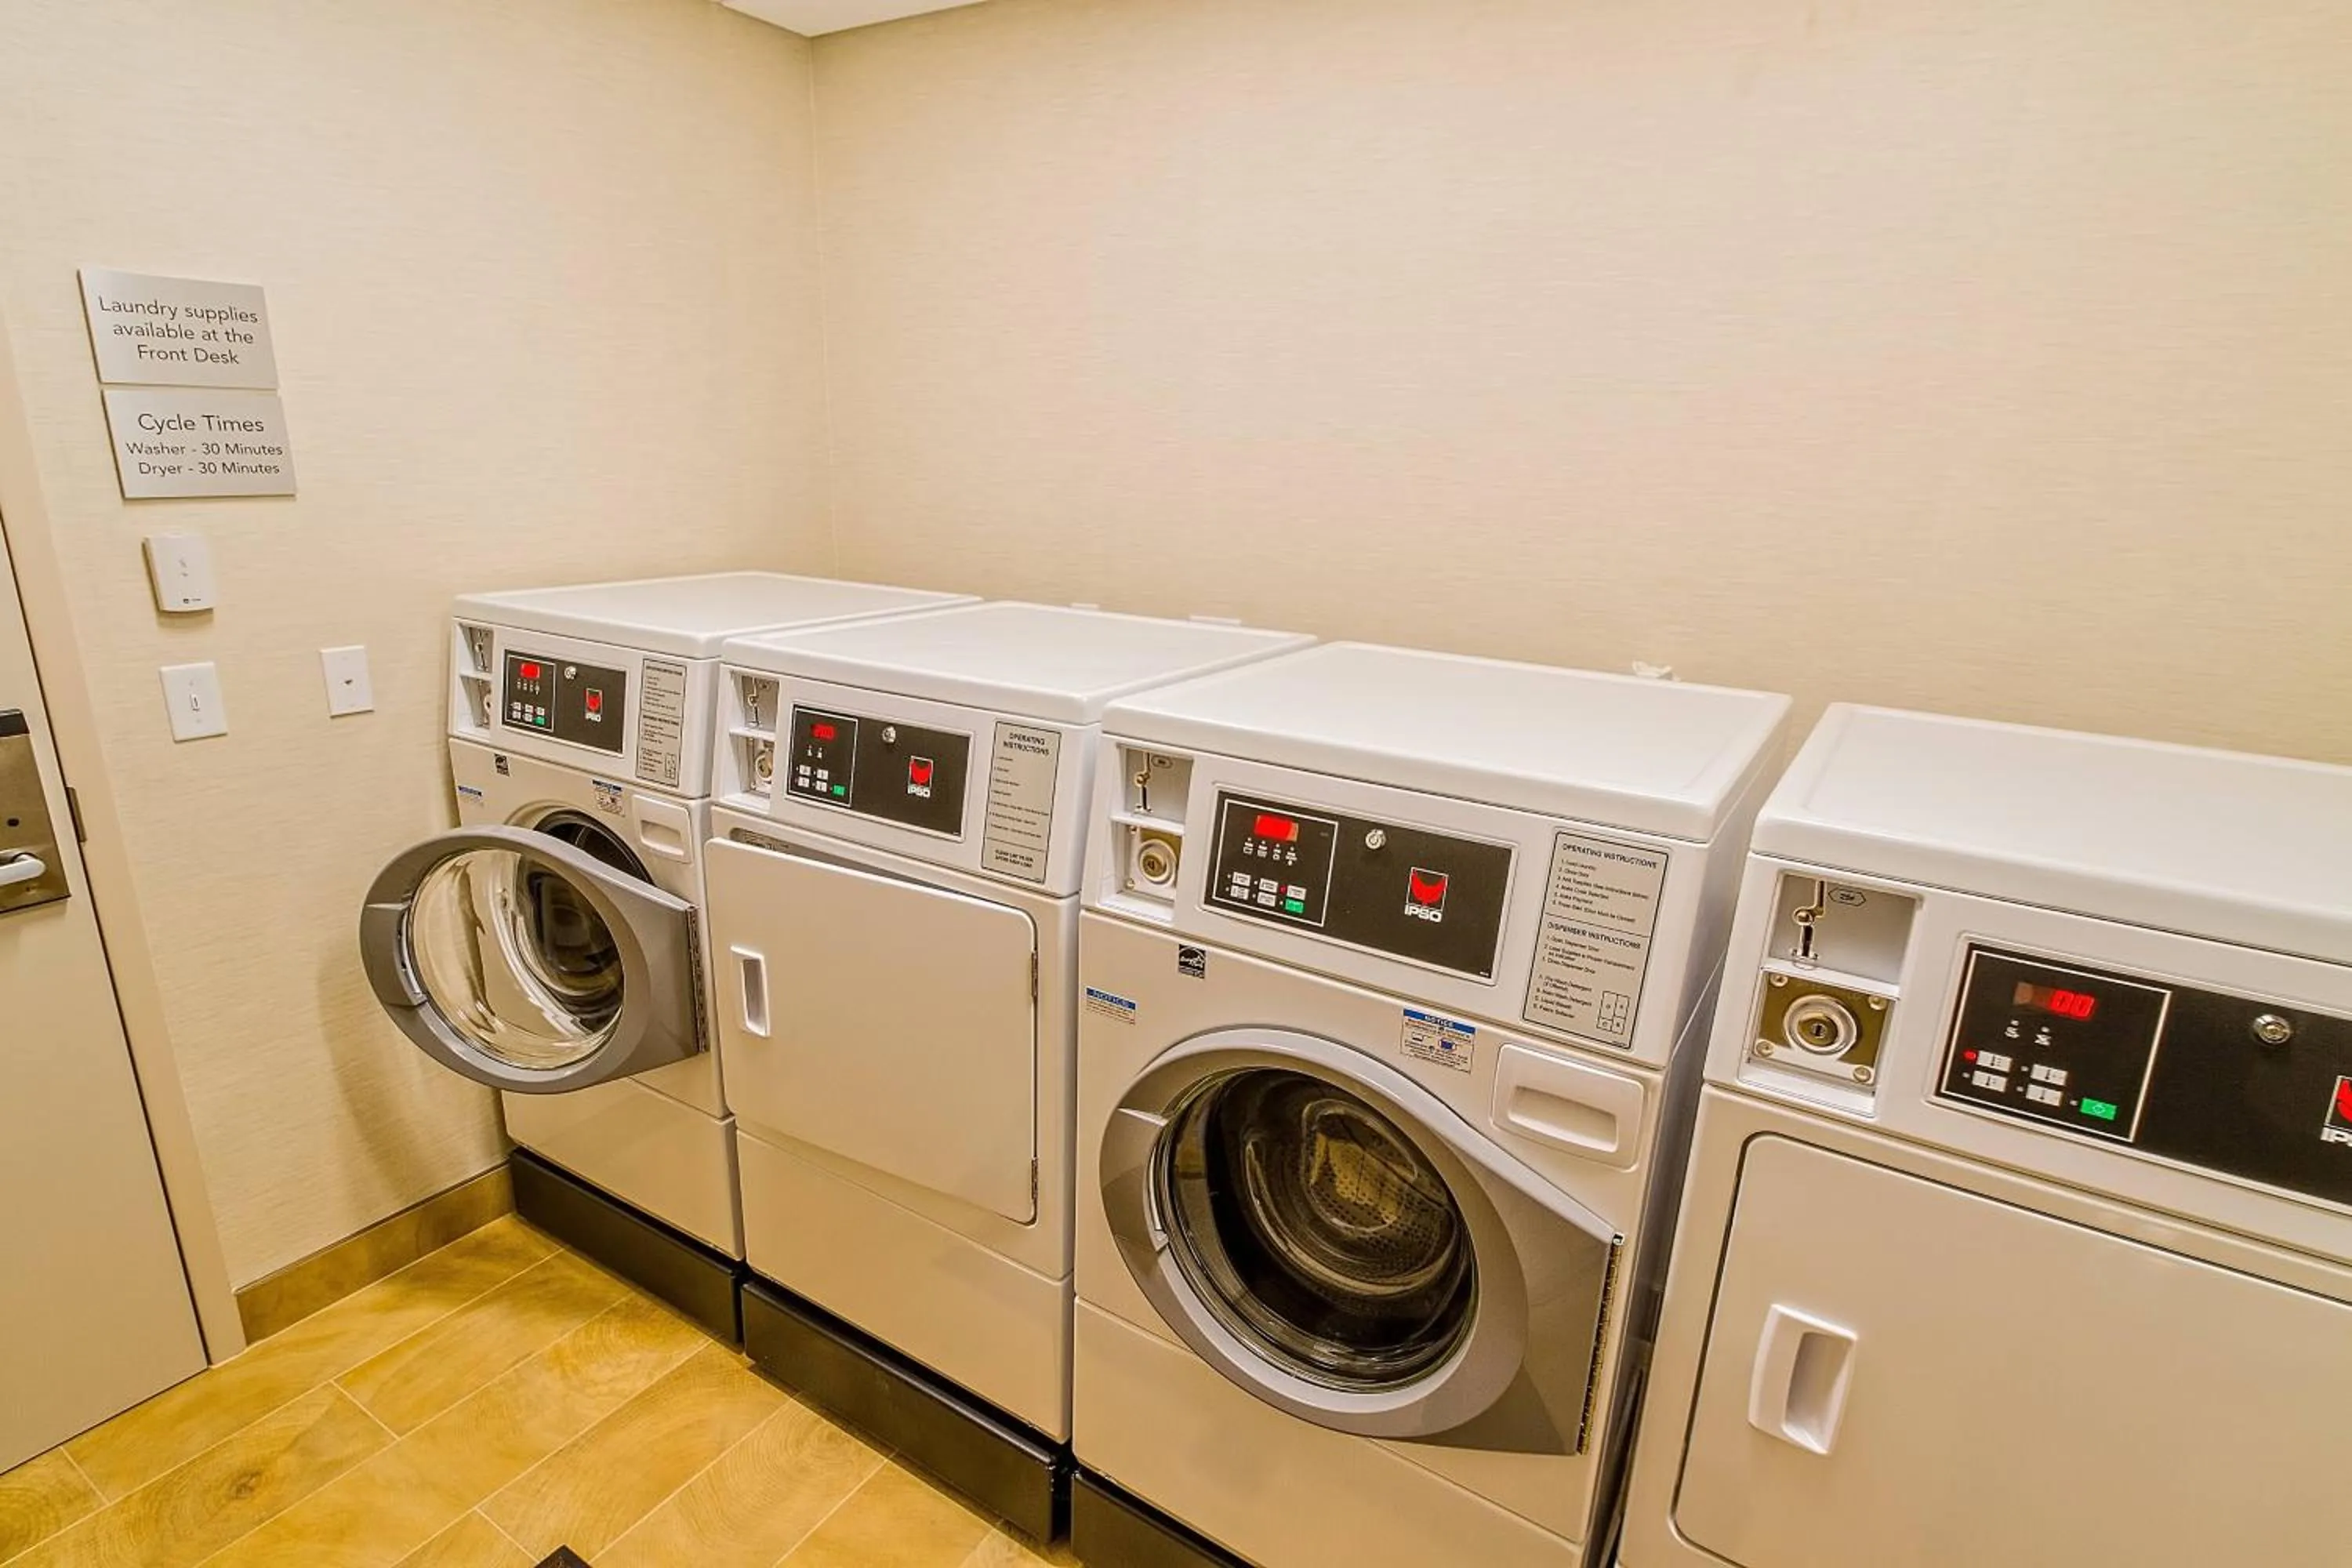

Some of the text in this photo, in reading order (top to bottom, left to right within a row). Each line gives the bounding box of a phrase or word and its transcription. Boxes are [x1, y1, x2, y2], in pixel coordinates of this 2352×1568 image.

[99, 295, 259, 325] Laundry supplies
[113, 322, 254, 344] available at the
[137, 344, 239, 365] Front Desk
[138, 413, 265, 434] Cycle Times
[125, 441, 186, 456] Washer
[201, 442, 220, 456] 30
[225, 442, 283, 456] Minutes
[138, 462, 183, 477] Dryer
[198, 462, 217, 474] 30
[222, 462, 280, 474] Minutes
[907, 784, 931, 798] IPSO
[1563, 844, 1602, 857] OPERATING
[1603, 852, 1657, 869] INSTRUCTIONS
[1404, 904, 1442, 923] IPSO
[1548, 921, 1588, 937] DISPENSER
[1588, 931, 1641, 949] INSTRUCTIONS
[2320, 1127, 2352, 1148] IP
